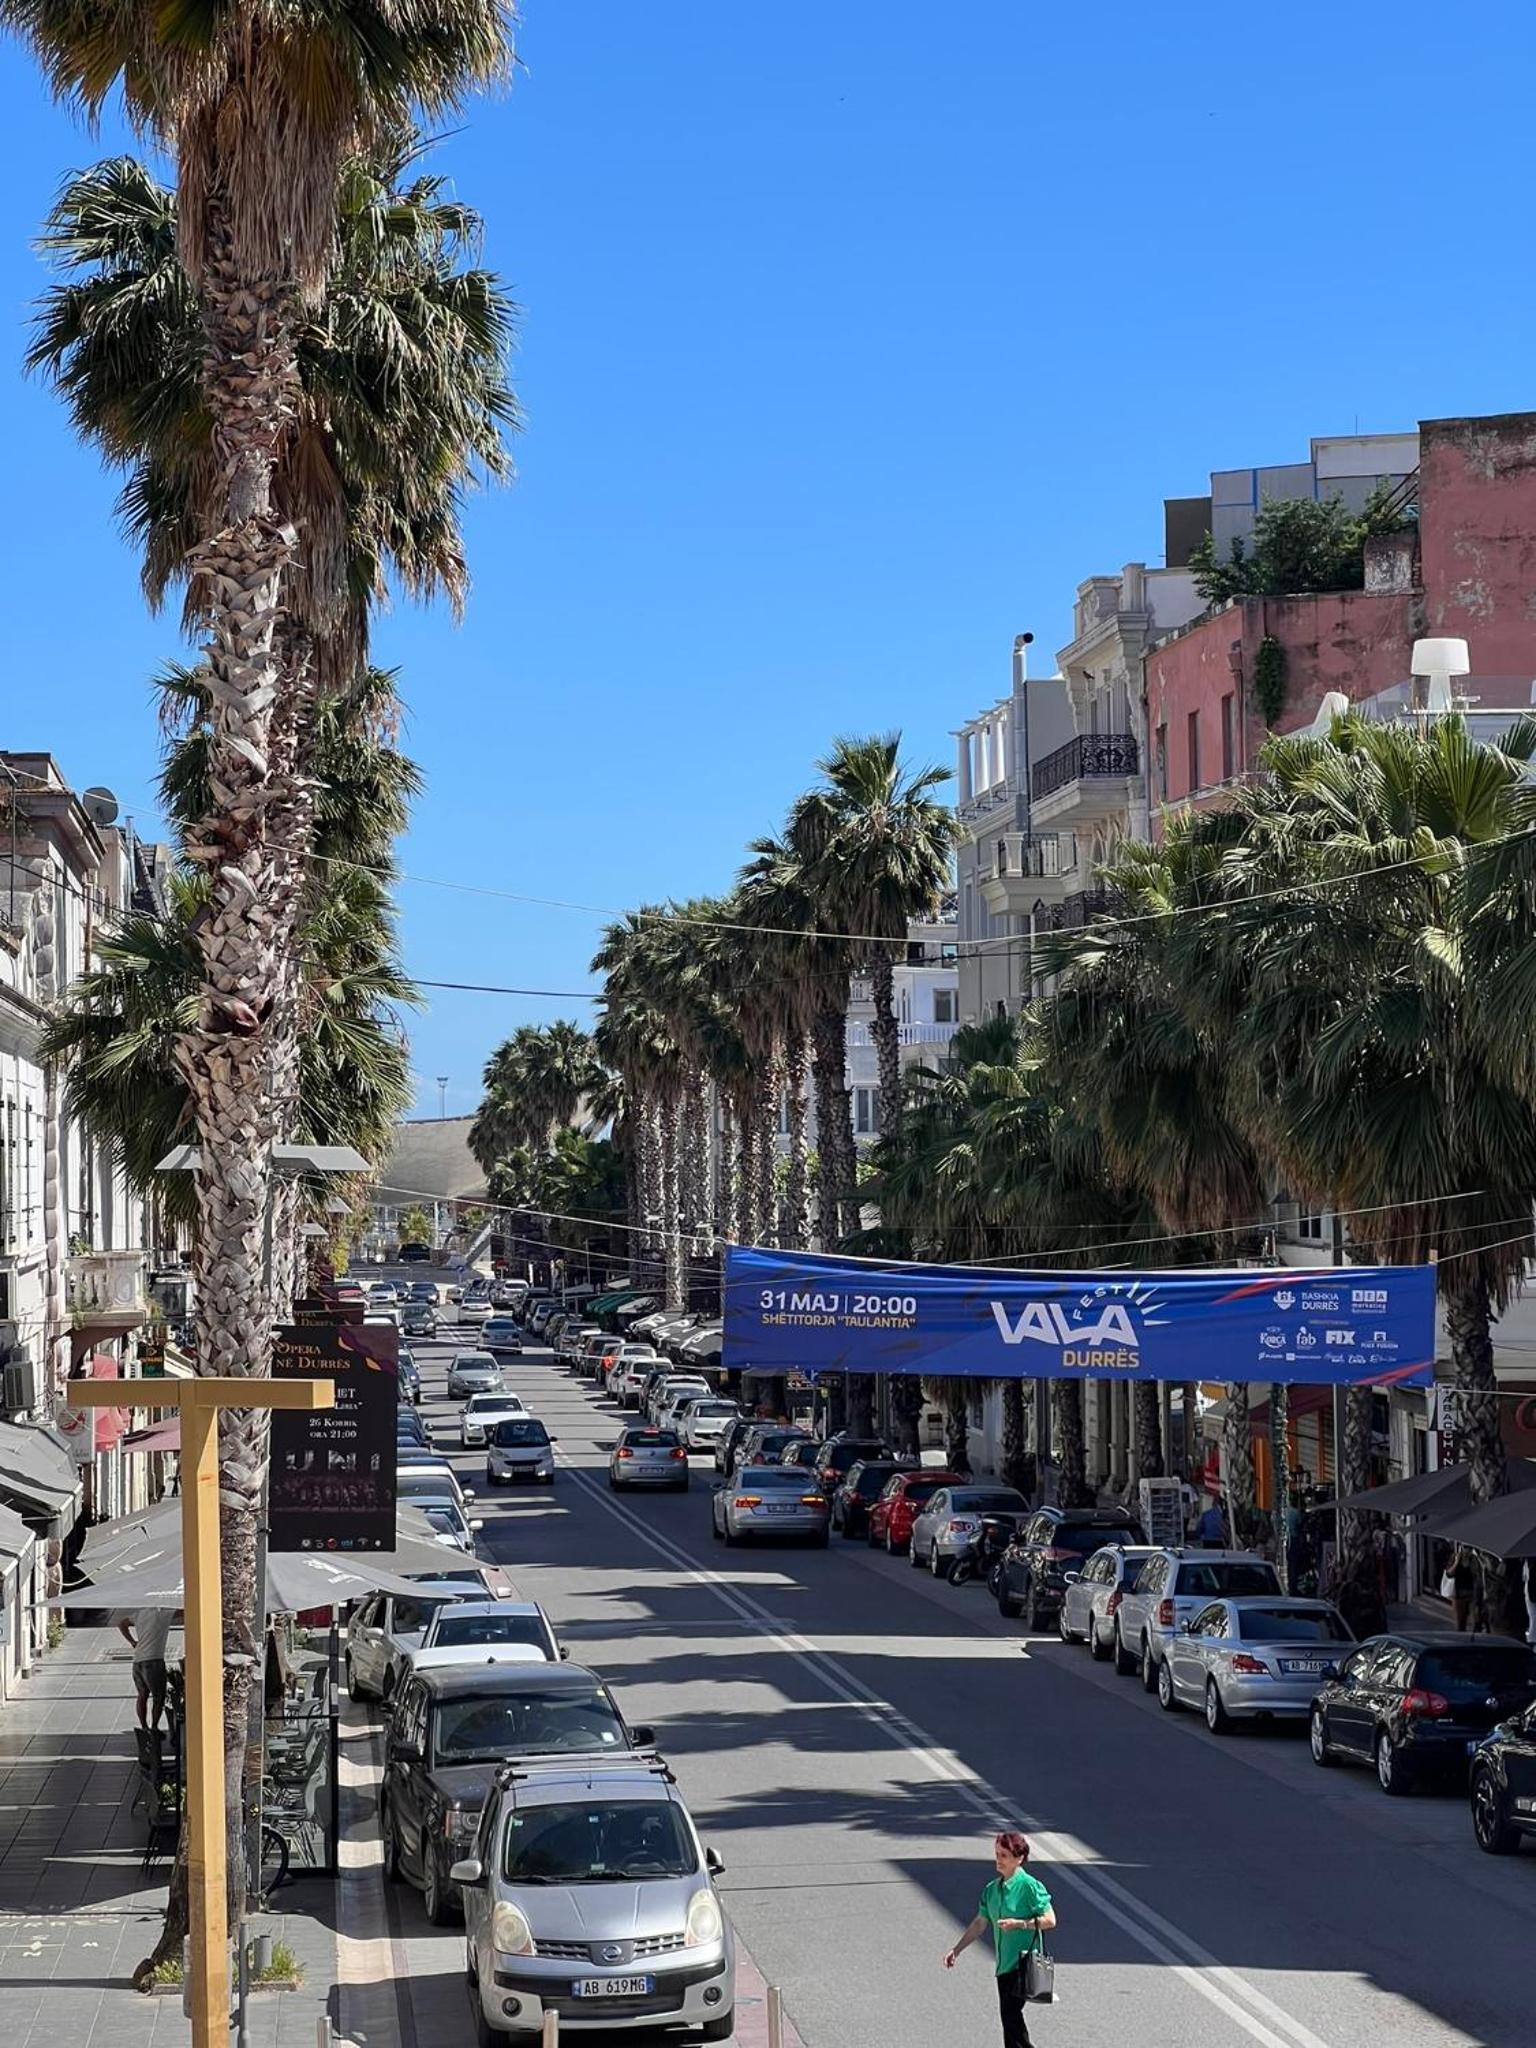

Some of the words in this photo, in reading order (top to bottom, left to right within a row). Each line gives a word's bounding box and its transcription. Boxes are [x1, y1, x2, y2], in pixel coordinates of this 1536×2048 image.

[760, 1290, 785, 1309] 31
[790, 1293, 839, 1312] MAJ
[853, 1296, 917, 1315] 20:00
[1072, 1284, 1124, 1321] FEST
[1301, 1292, 1339, 1301] BASHKIA
[762, 1312, 836, 1326] SHËTITORJA
[838, 1316, 916, 1328] "TAULANTIA"
[988, 1301, 1140, 1347] VALA
[1325, 1330, 1356, 1345] FIX
[1062, 1348, 1140, 1368] DURRËS
[309, 1418, 322, 1427] 26
[330, 1429, 357, 1439] 21:00
[584, 1981, 600, 1995] AB
